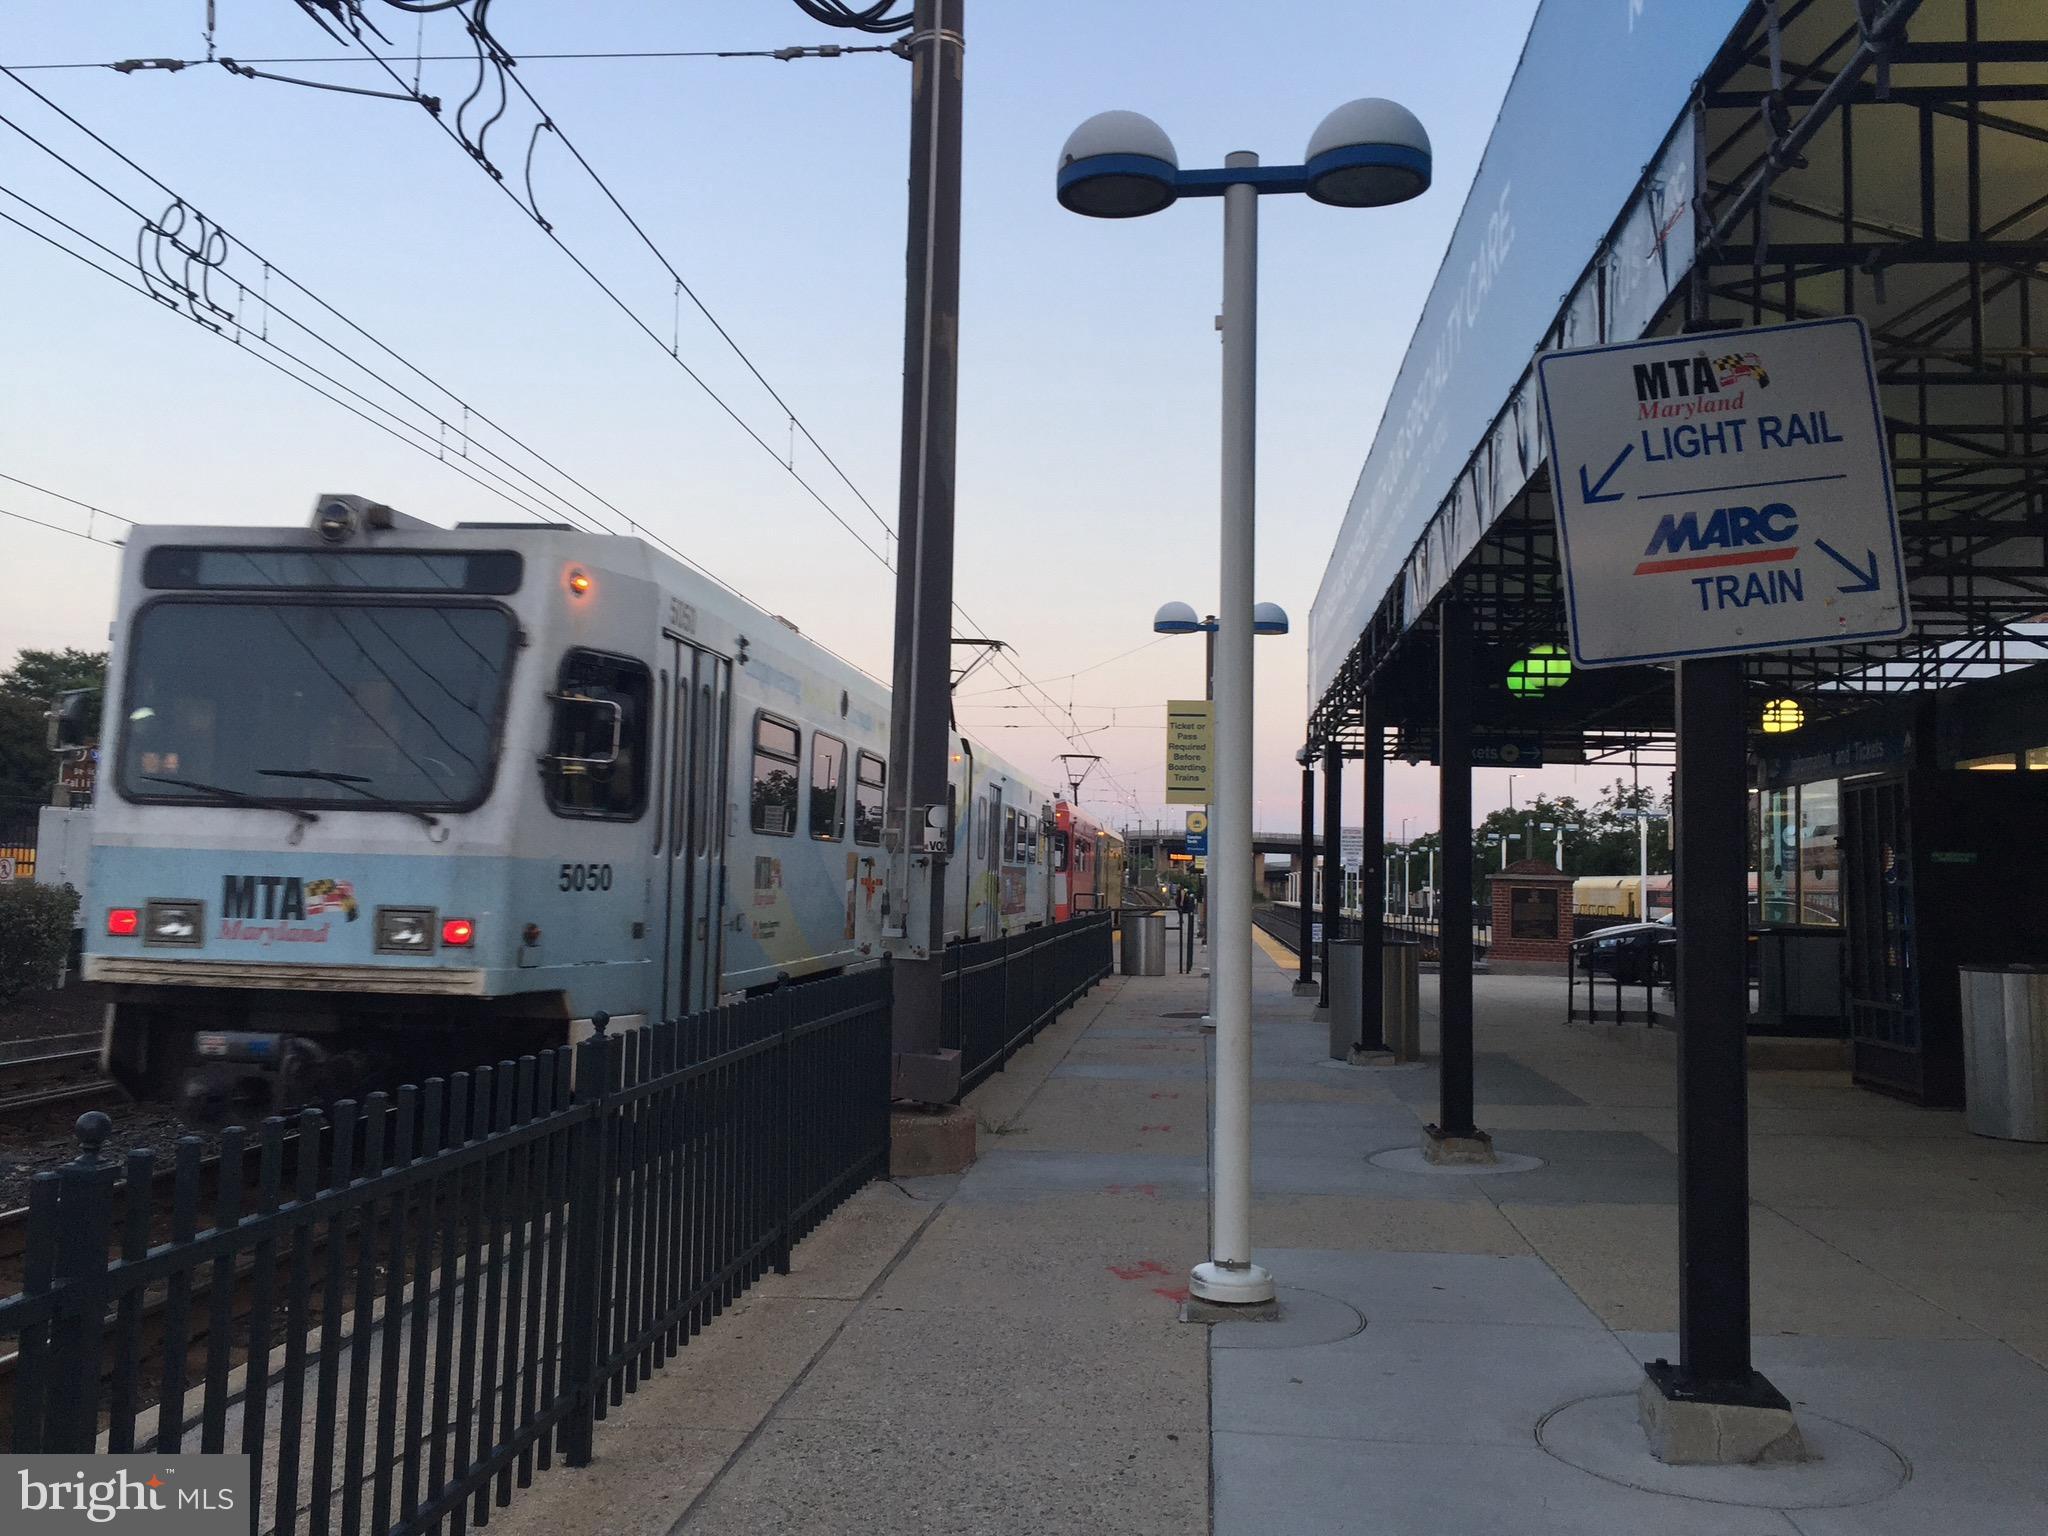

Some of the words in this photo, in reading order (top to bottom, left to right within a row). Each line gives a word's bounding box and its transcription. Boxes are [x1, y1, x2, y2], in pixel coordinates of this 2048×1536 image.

[1633, 356, 1720, 401] MTA
[1637, 391, 1745, 421] Maryland
[1641, 419, 1747, 462] LIGHT
[1758, 411, 1844, 450] RAIL
[1644, 503, 1800, 556] MARC
[1691, 569, 1804, 611] TRAIN
[1169, 722, 1194, 730] Ticket
[1177, 732, 1198, 740] Pass
[1168, 743, 1206, 752] Required
[1173, 753, 1201, 761] Before
[1168, 763, 1207, 773] Boarding
[1174, 773, 1199, 781] Trains
[559, 863, 613, 892] 5050
[222, 875, 305, 920] MTA
[215, 919, 332, 946] Maryland
